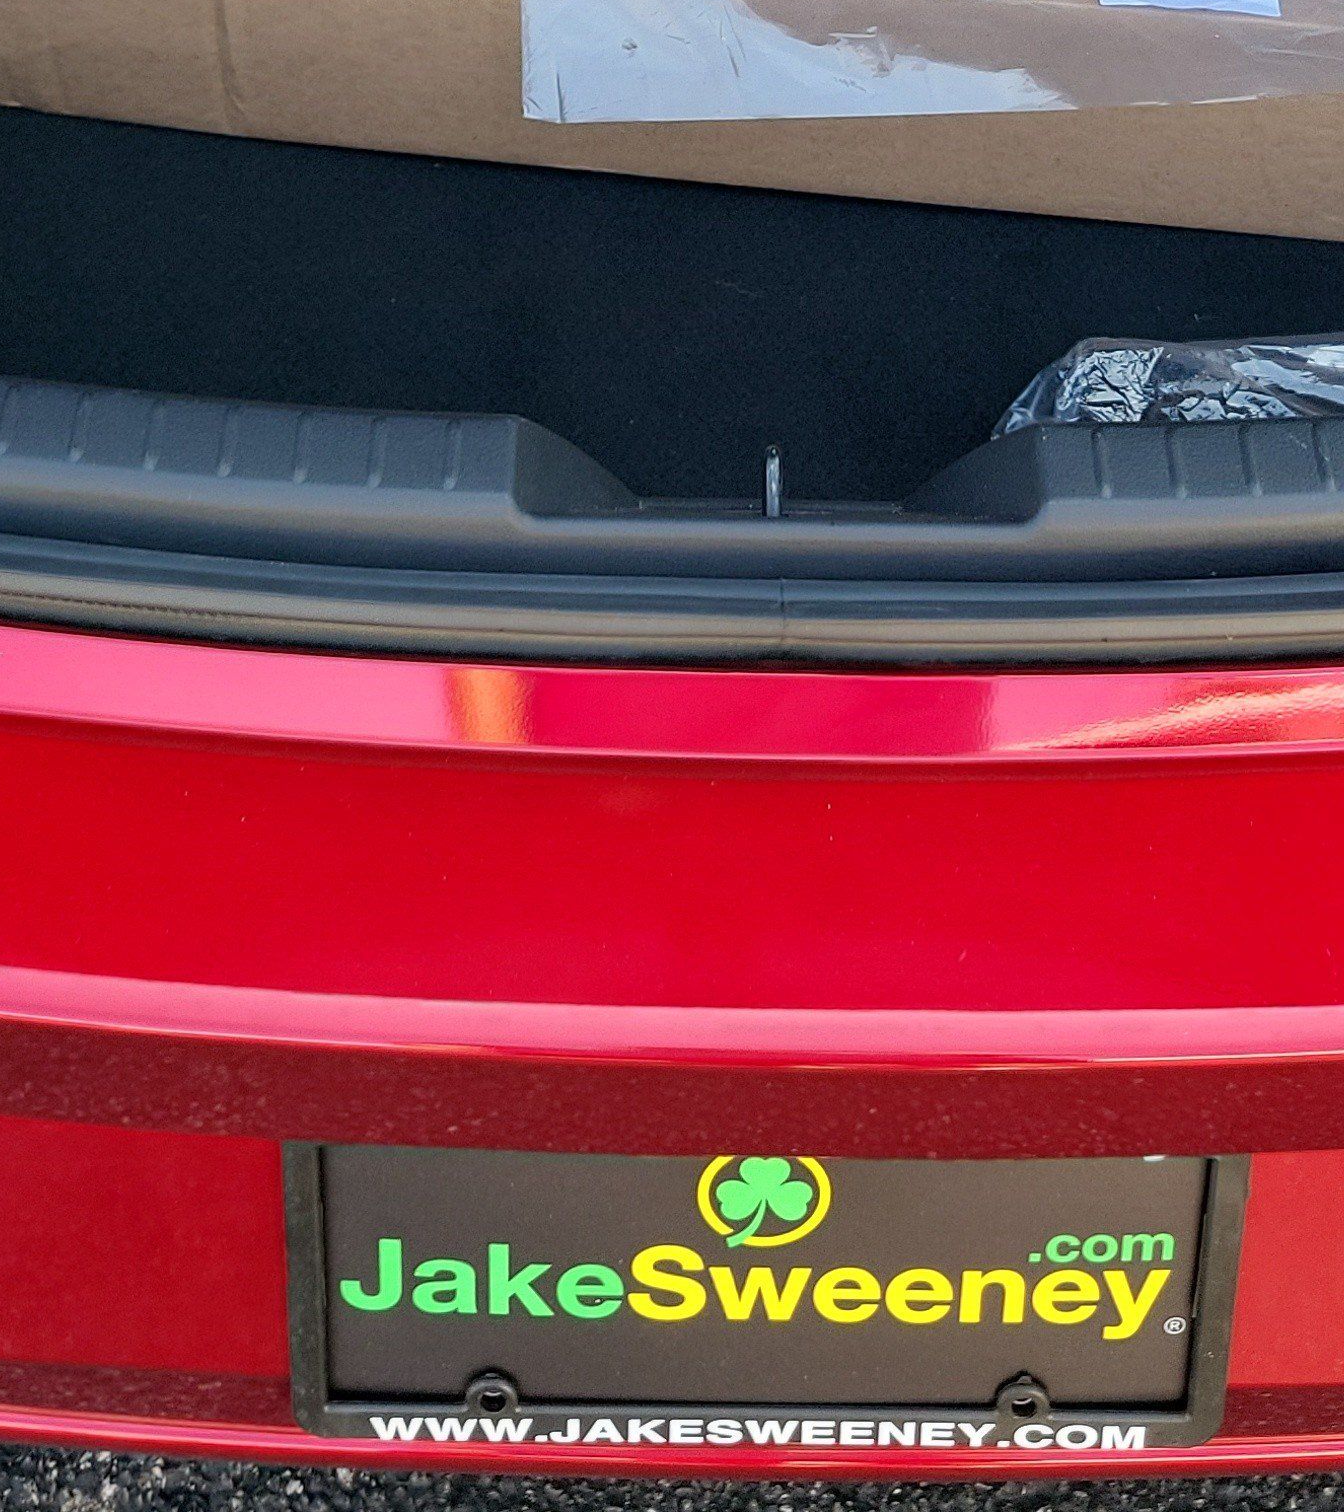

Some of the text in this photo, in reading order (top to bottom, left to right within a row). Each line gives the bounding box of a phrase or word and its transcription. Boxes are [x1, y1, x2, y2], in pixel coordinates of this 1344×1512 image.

[1027, 1232, 1175, 1264] .com
[339, 1237, 1172, 1340] JakeSweeney
[369, 1416, 1147, 1450] WWW.JAKESWEENEY.COM
